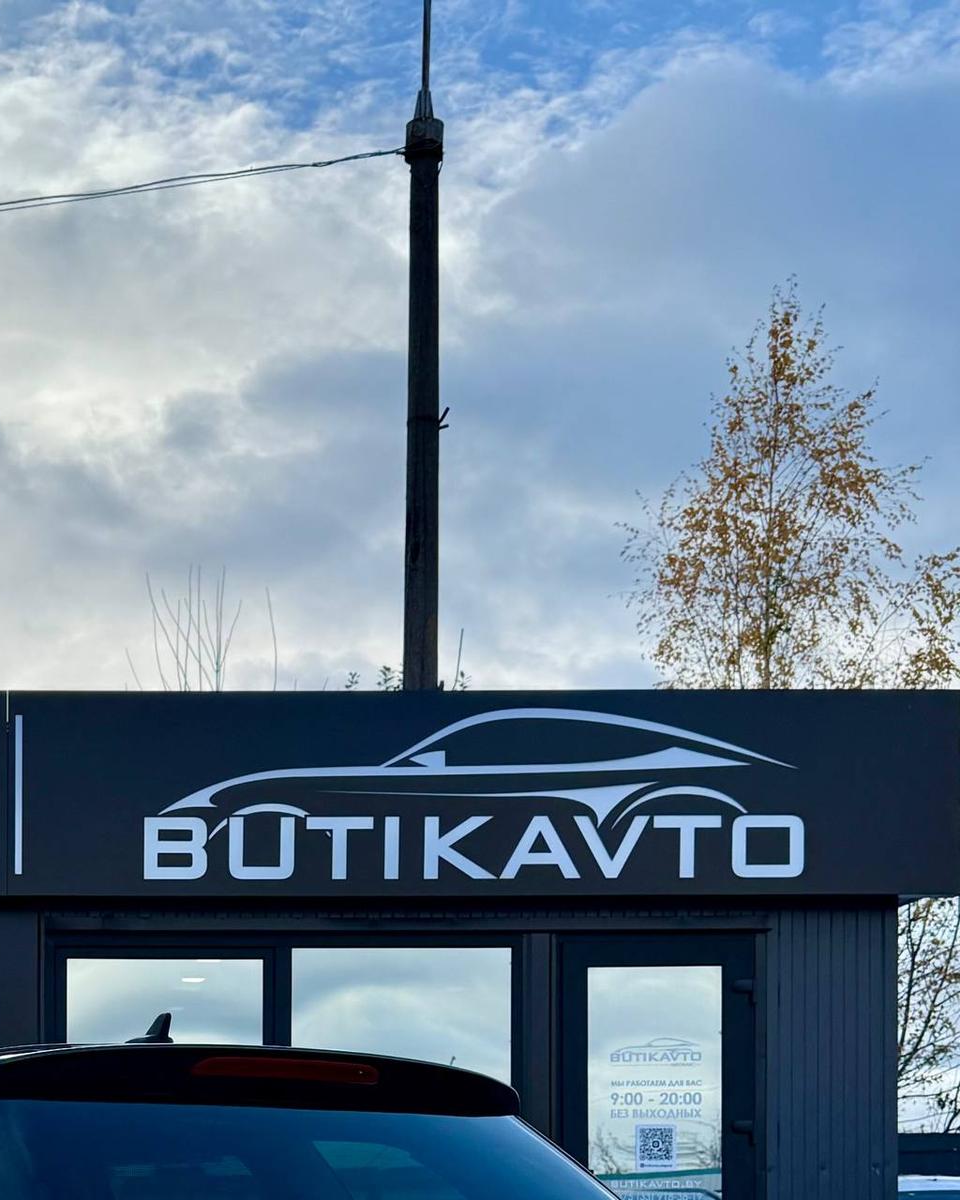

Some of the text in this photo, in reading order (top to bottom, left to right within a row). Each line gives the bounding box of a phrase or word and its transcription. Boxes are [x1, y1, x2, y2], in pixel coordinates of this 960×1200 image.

[143, 813, 805, 881] BUTIKAVTO
[610, 1052, 702, 1063] BUTIKAVTO
[610, 1092, 643, 1106] 9:00
[659, 1092, 702, 1106] 20:00
[610, 1108, 702, 1119] БЕЗ ВЫХОДНЫХ
